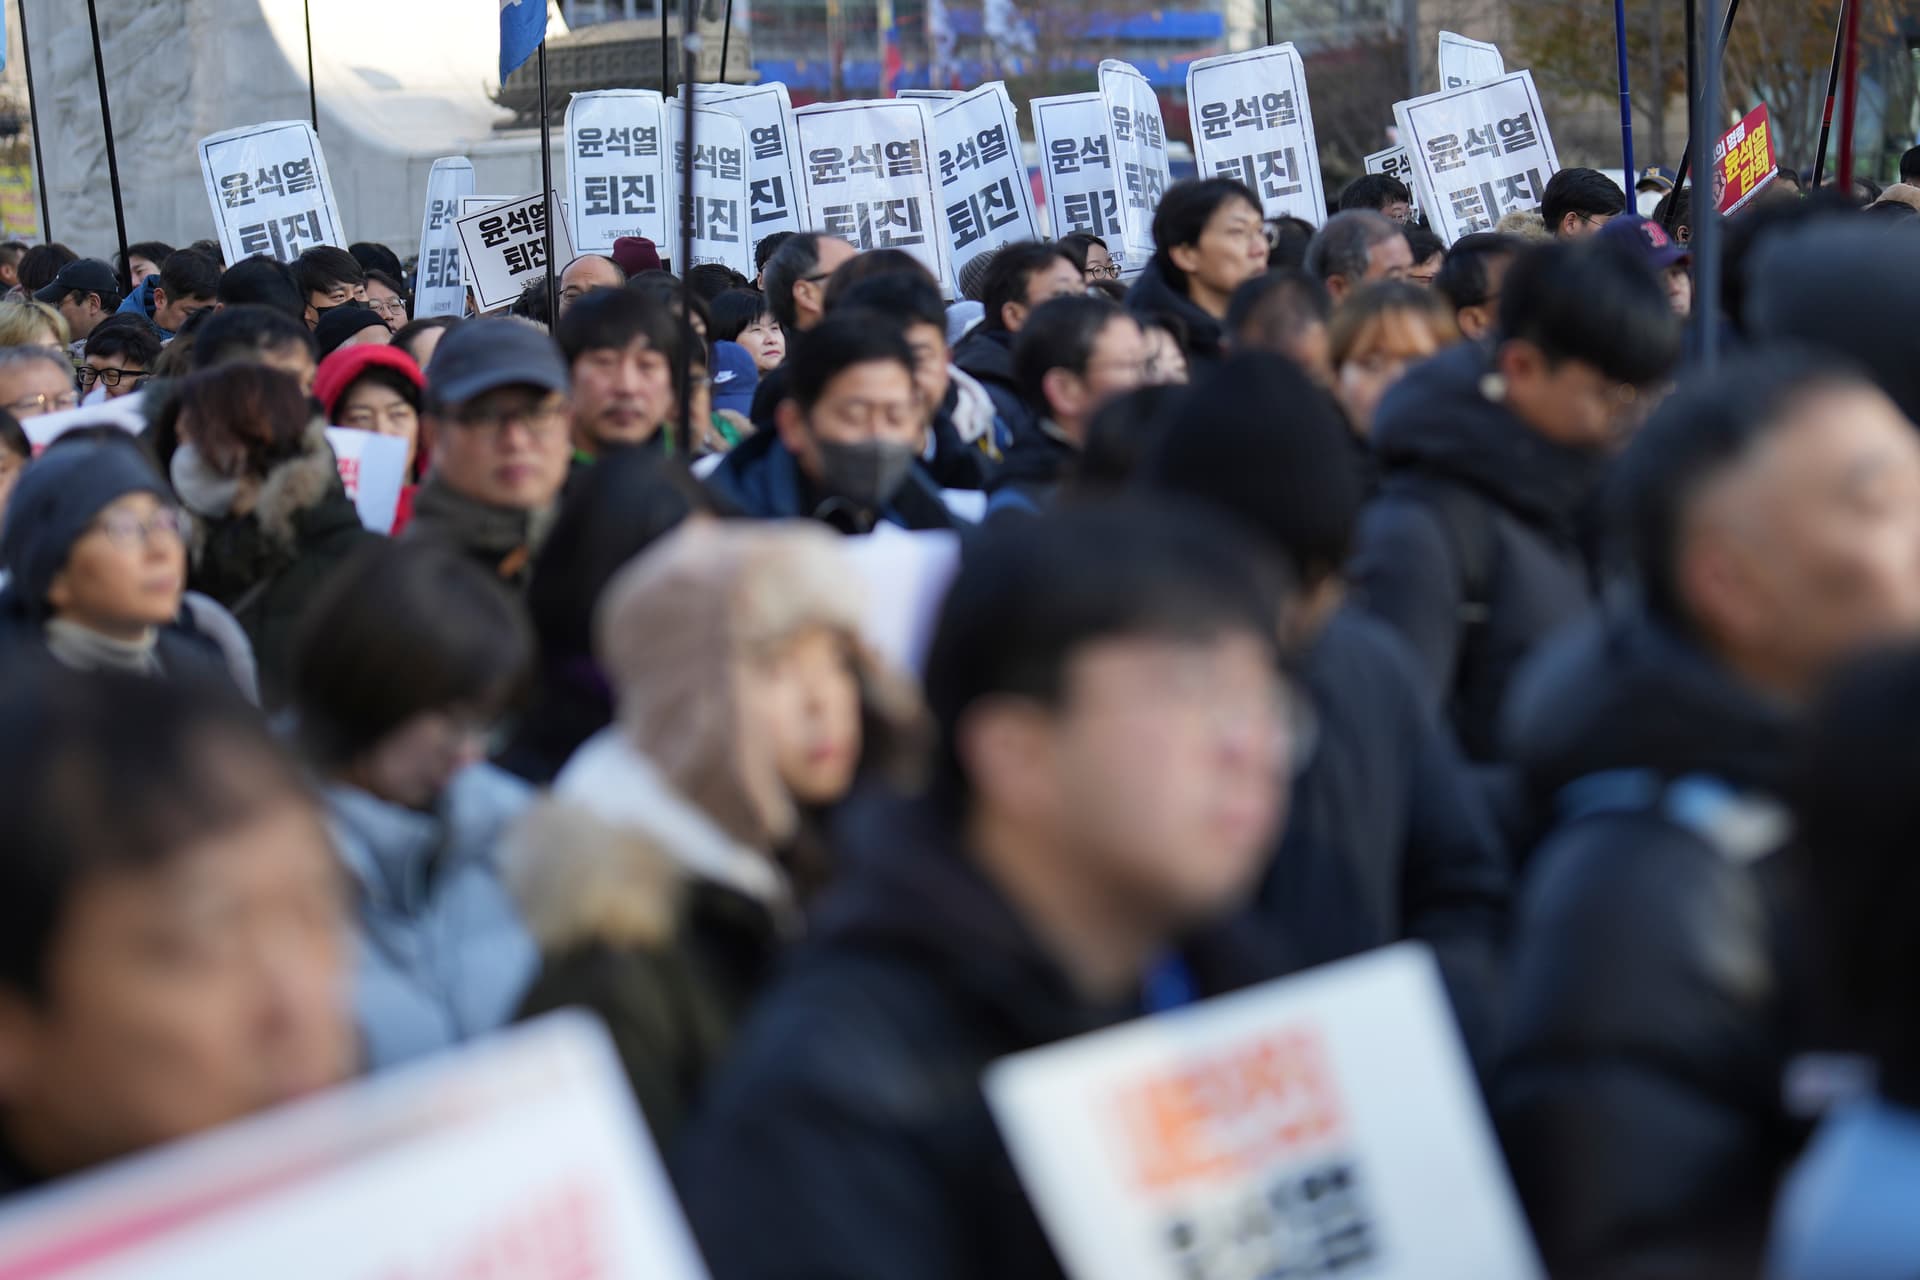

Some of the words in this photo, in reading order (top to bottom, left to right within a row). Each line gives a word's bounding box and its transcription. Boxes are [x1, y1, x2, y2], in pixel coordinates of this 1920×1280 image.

[1113, 105, 1162, 150] 윤석열
[1201, 90, 1297, 140] 윤석열
[1726, 122, 1745, 151] 명령
[577, 126, 658, 158] 윤석열
[808, 138, 923, 185] 윤석열
[939, 124, 1008, 187] 윤석열
[1051, 134, 1111, 175] 윤석
[1382, 152, 1412, 180] 윤석
[1427, 112, 1538, 173] 윤석열
[1724, 121, 1768, 184] 윤석열
[220, 157, 317, 209] 윤석열
[584, 175, 656, 216] 퇴진
[1740, 147, 1770, 196] 탄핵
[429, 199, 459, 230] 윤석
[478, 200, 546, 248] 윤석열
[823, 197, 925, 250] 퇴진
[946, 177, 1019, 250] 퇴진
[1448, 167, 1545, 237] 퇴진
[238, 210, 324, 262] 퇴진
[503, 237, 547, 276] 퇴진
